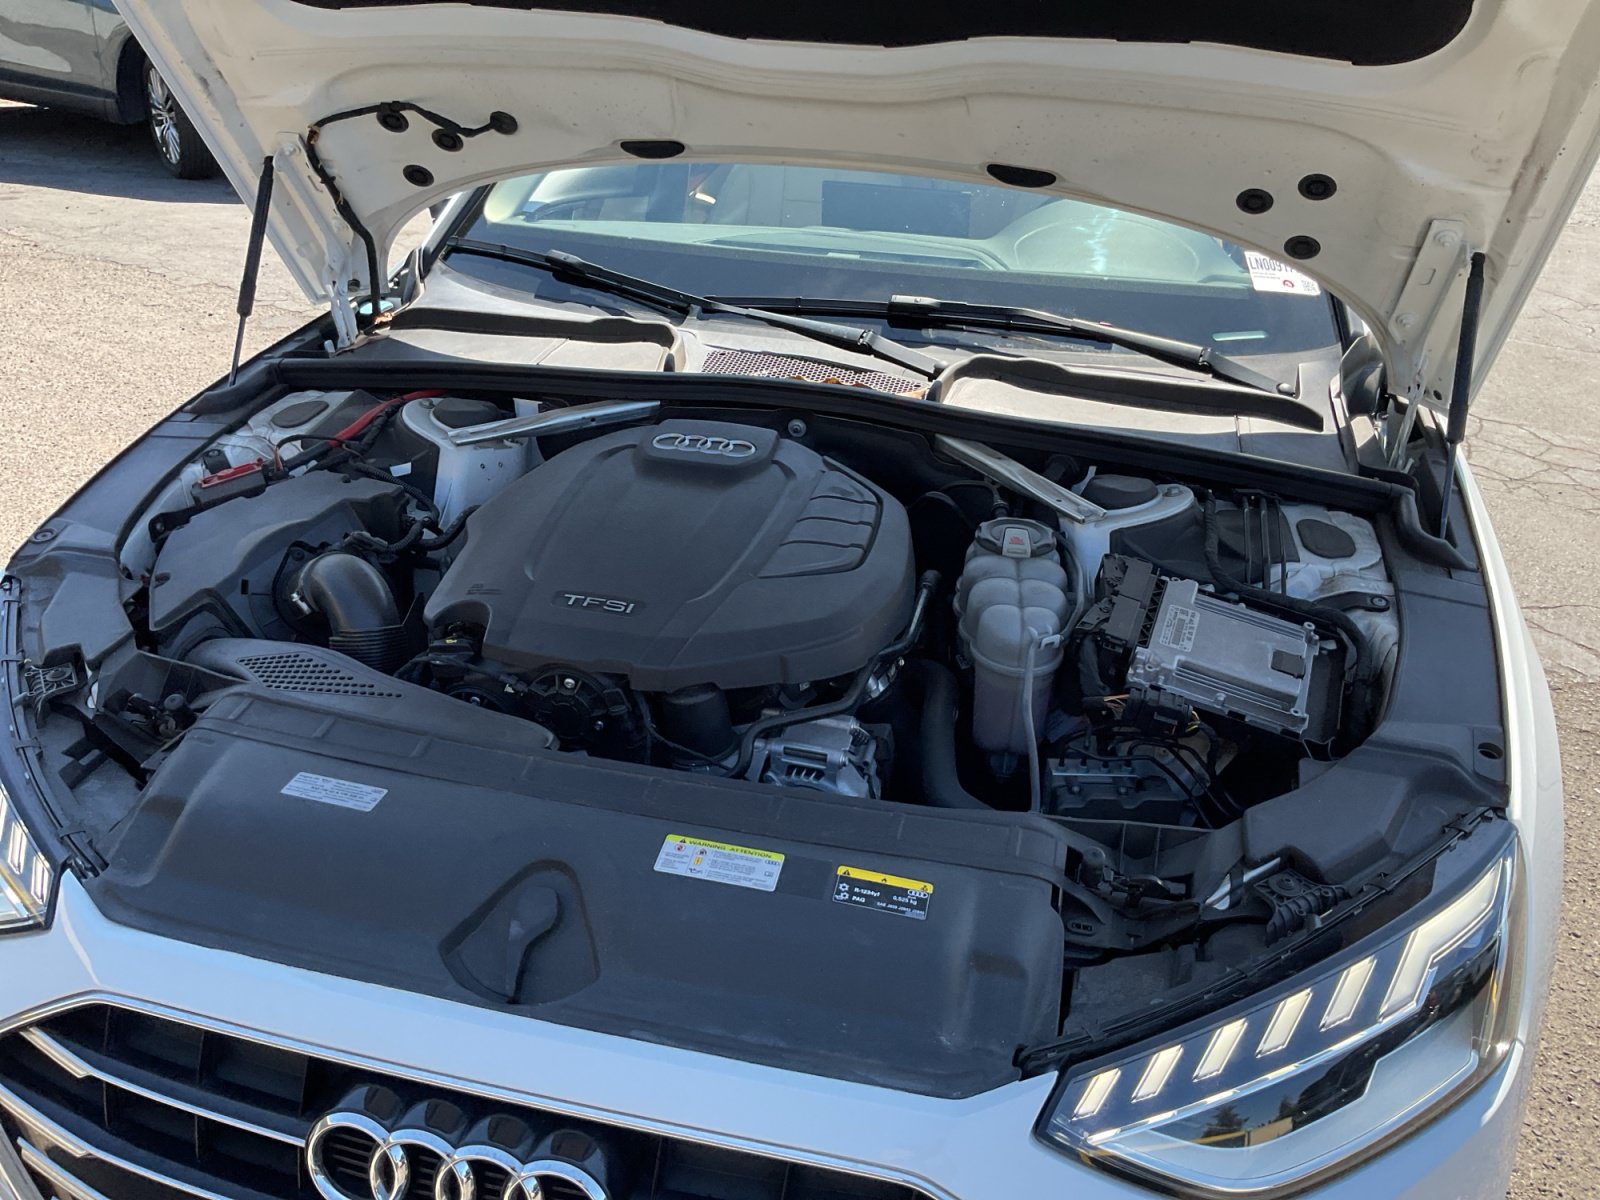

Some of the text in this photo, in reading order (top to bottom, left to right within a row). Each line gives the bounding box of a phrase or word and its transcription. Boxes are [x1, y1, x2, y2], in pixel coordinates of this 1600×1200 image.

[564, 594, 635, 613] TFSI
[689, 840, 772, 859] WARNING ATTENTION
[852, 895, 866, 903] PAG
[910, 897, 917, 905] kg
